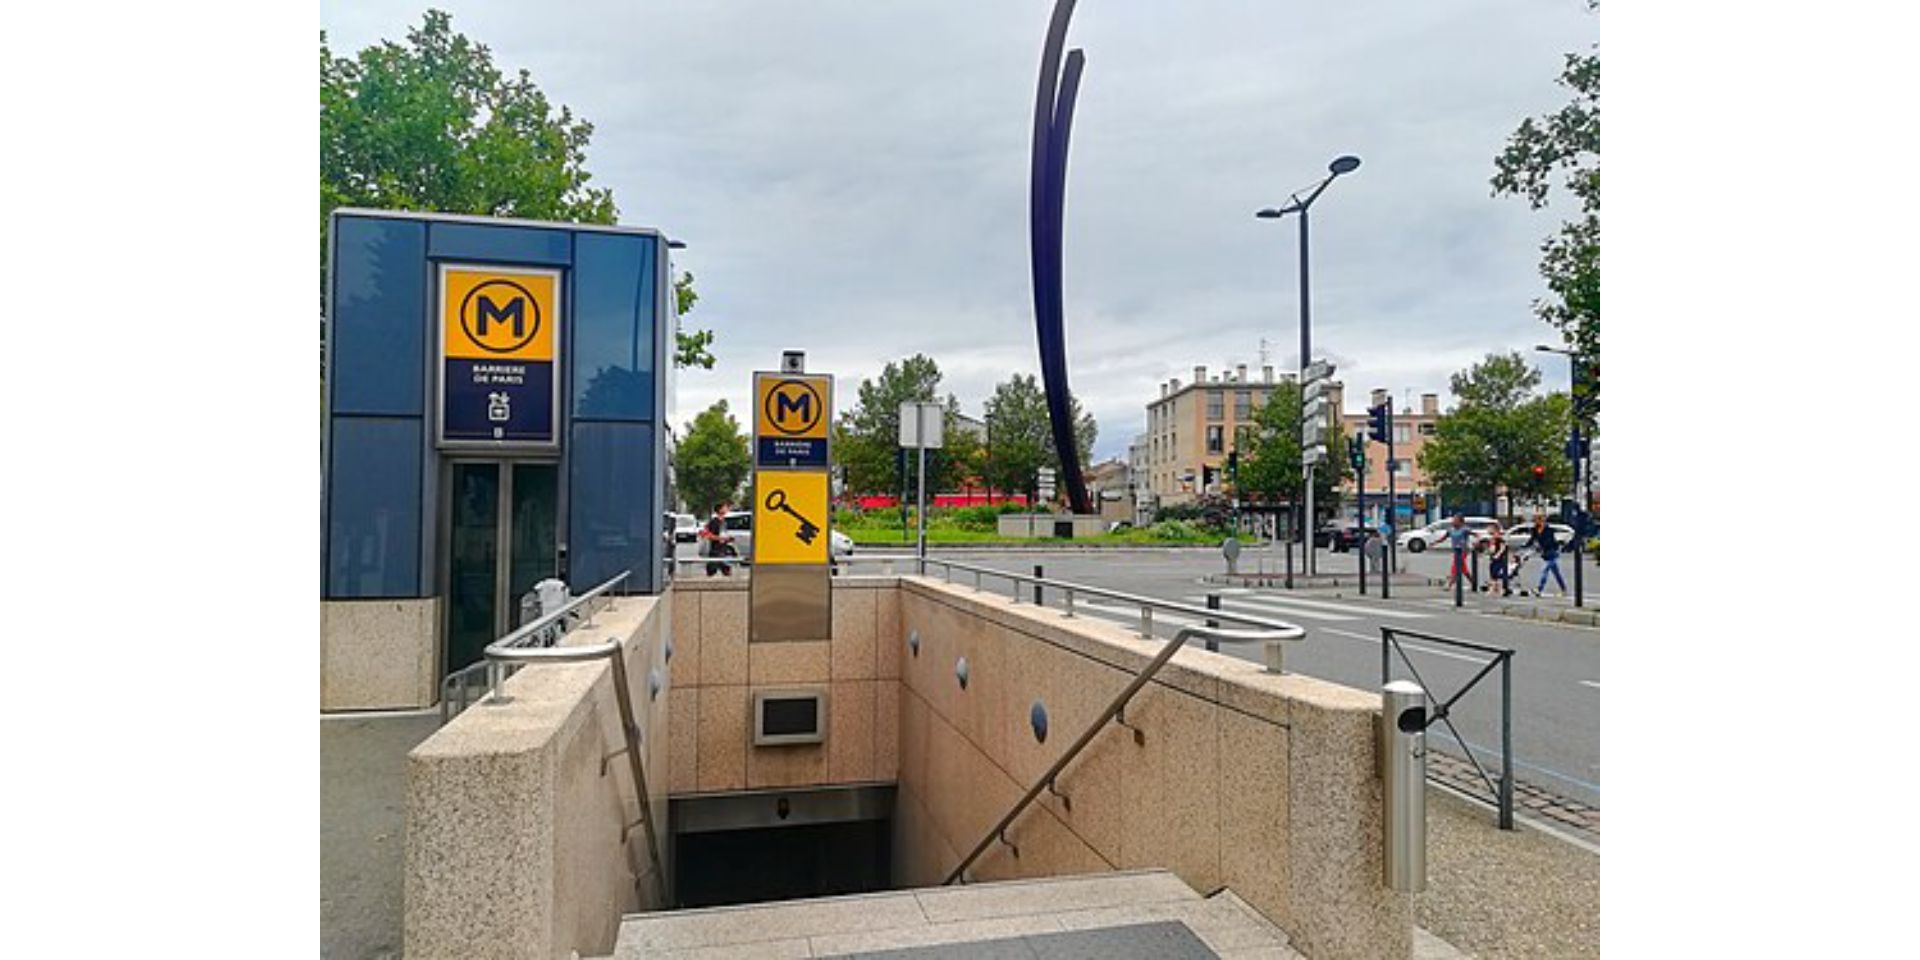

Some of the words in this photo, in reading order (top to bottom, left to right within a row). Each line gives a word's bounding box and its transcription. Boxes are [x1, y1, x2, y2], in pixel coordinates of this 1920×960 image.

[478, 296, 524, 337] M
[473, 375, 487, 383] DE
[491, 375, 523, 384] PARIS
[777, 391, 810, 423] M
